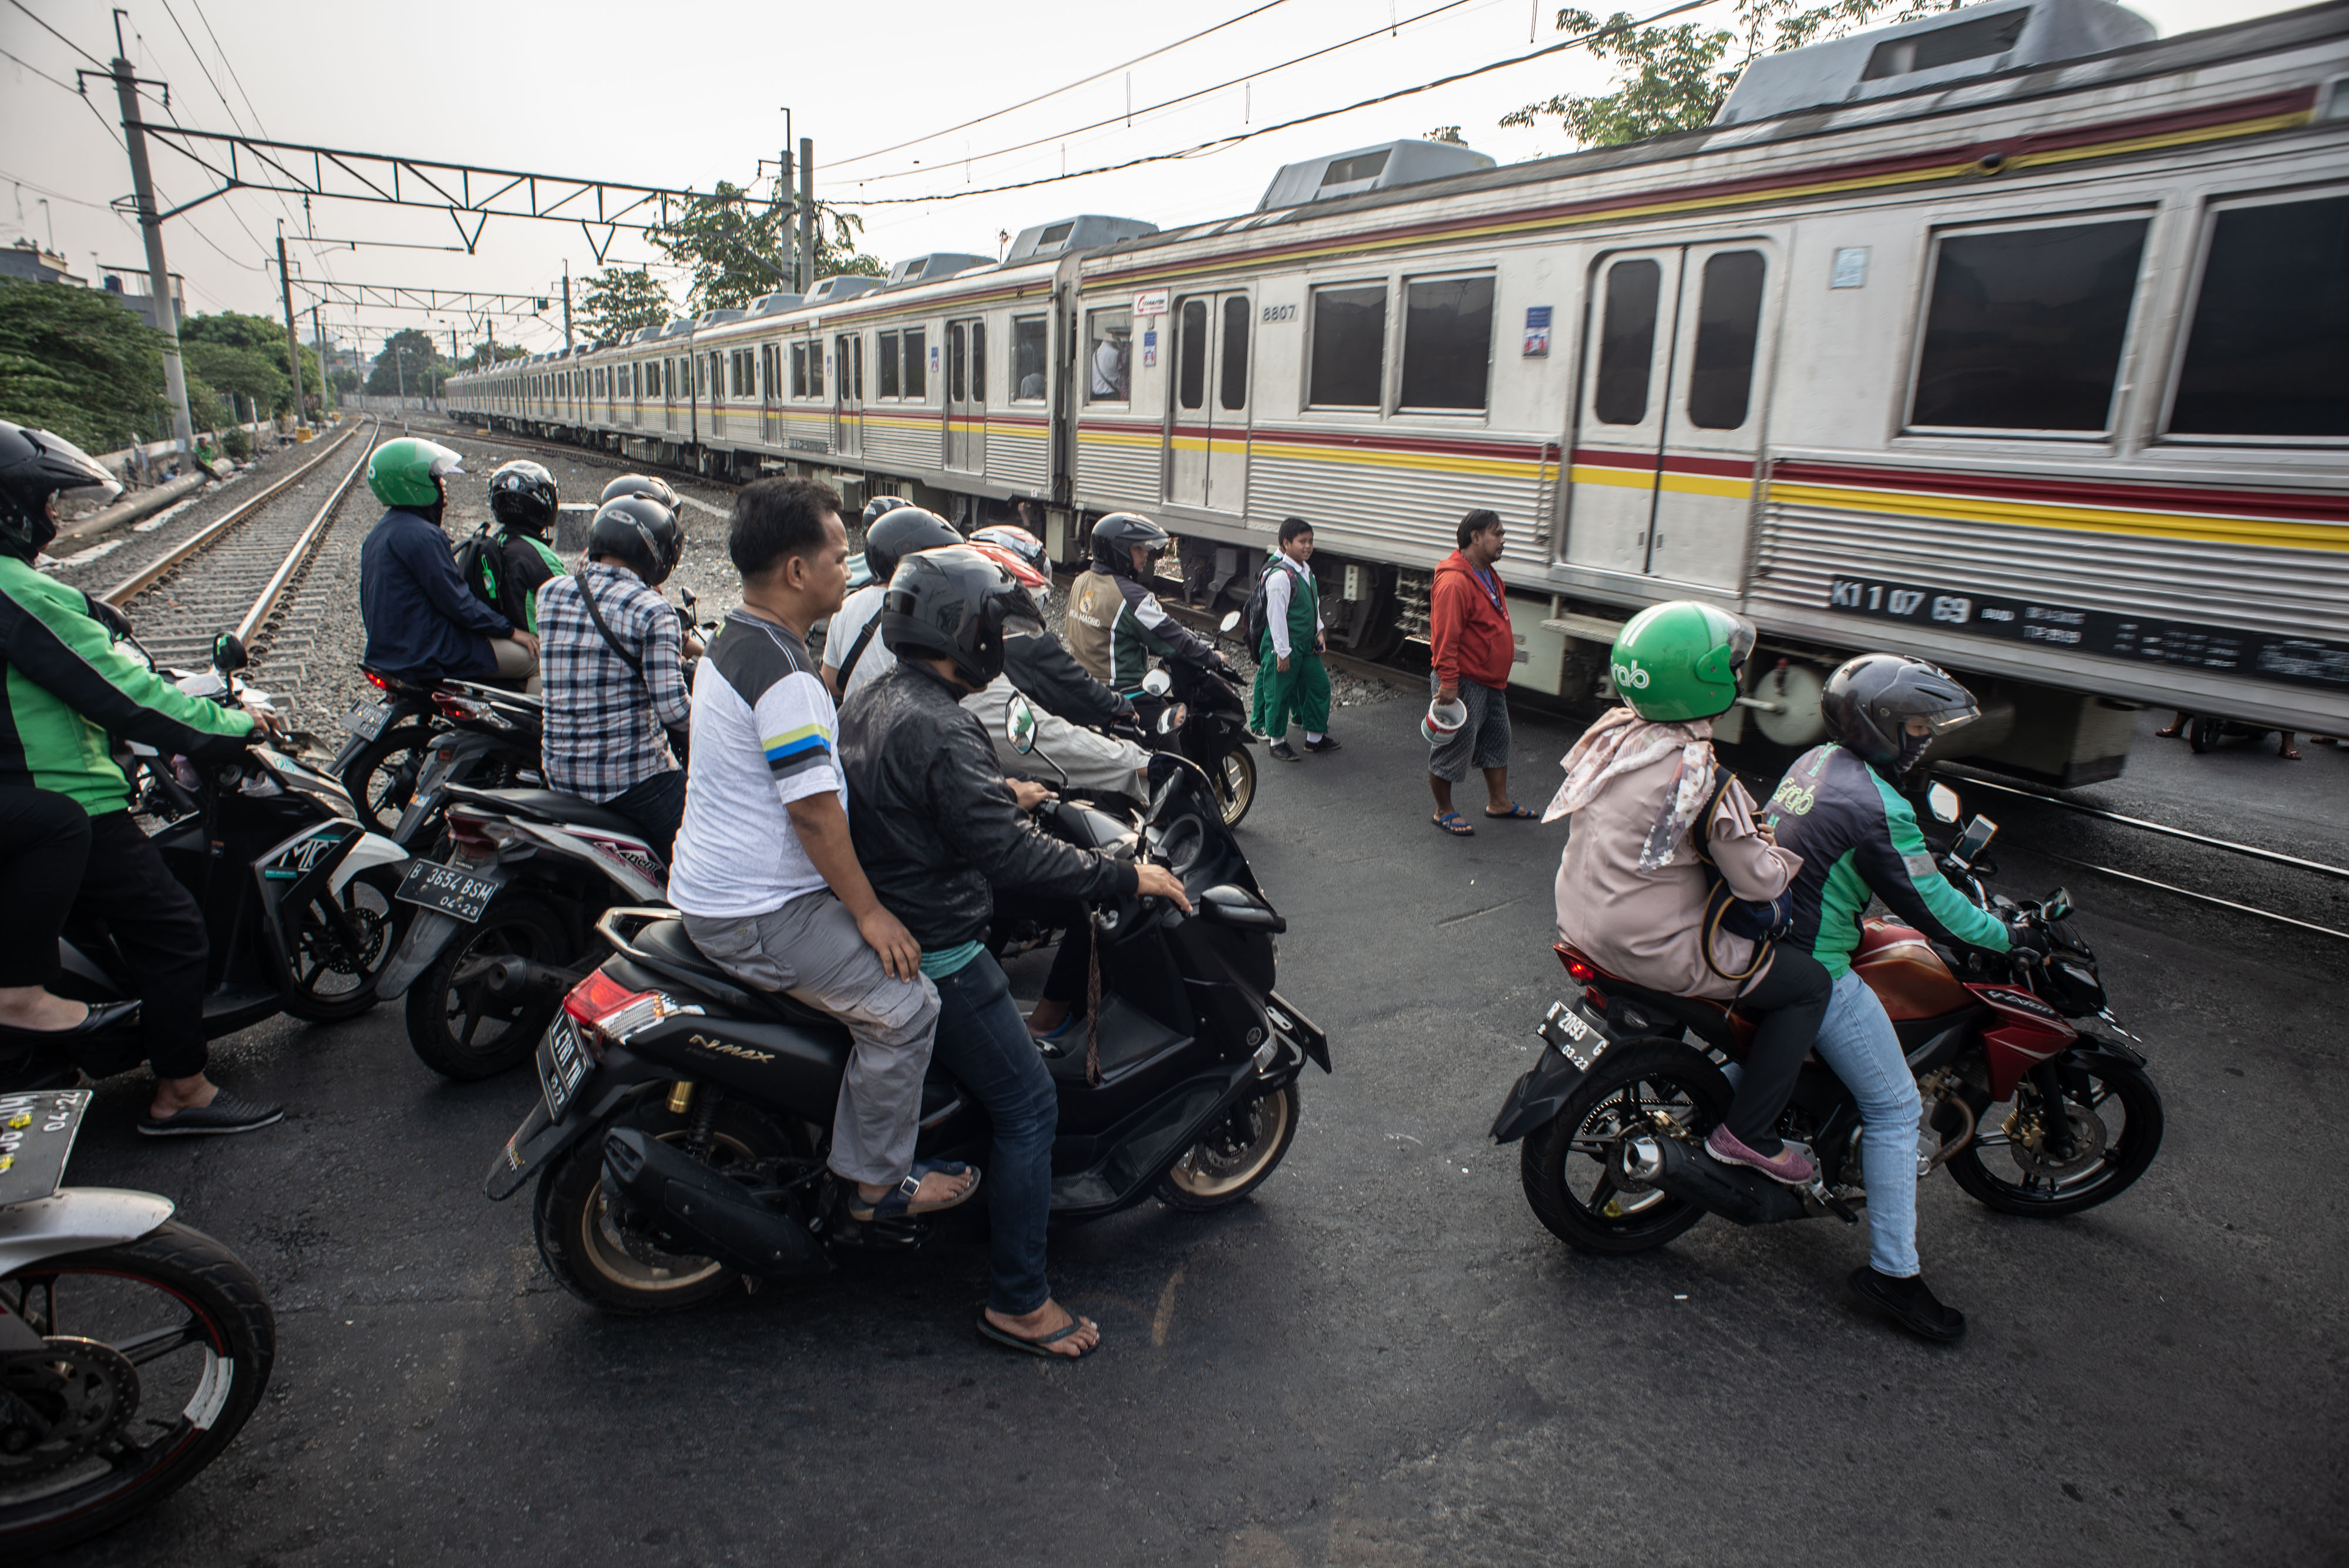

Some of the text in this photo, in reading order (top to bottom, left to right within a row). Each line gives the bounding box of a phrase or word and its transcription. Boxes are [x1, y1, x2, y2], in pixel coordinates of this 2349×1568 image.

[1263, 305, 1296, 321] 8807
[1832, 580, 1863, 607] K1
[1868, 586, 1883, 610] 1
[1887, 590, 1926, 615] 07
[1931, 595, 1971, 623] 69
[1079, 613, 1101, 628] MADRID
[1611, 655, 1650, 689] rab
[1772, 777, 1816, 816] Grab
[455, 860, 473, 870] HONDA
[410, 863, 493, 902] B 3654 BSM
[1546, 1001, 1560, 1020] R
[1557, 1012, 1588, 1041] 2093
[689, 1034, 775, 1064] NMAX
